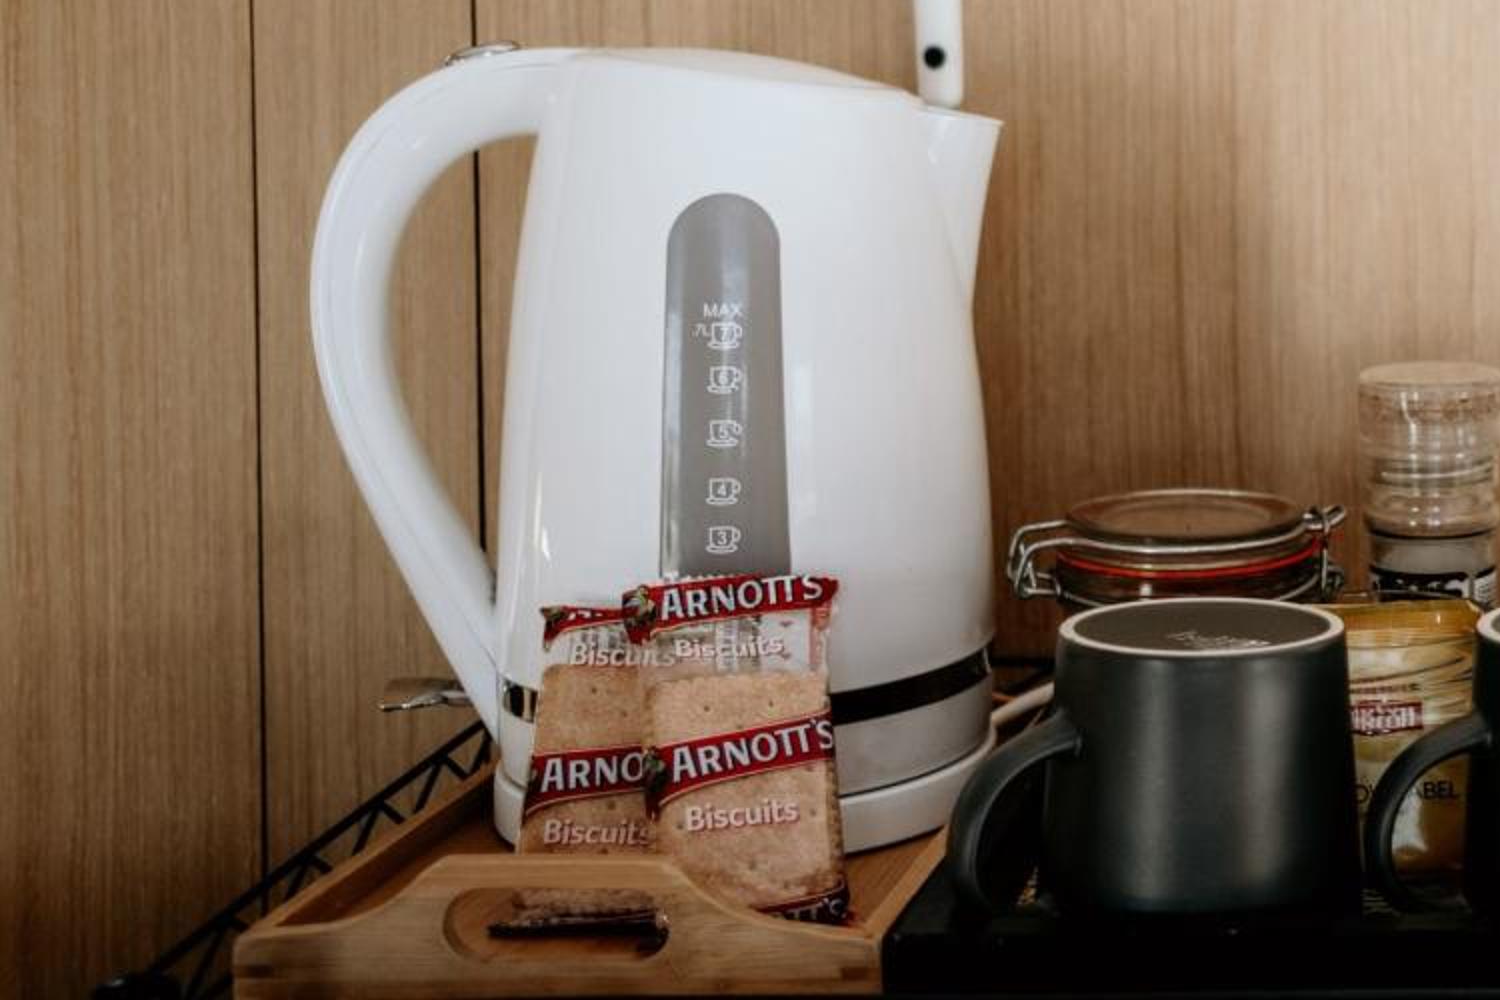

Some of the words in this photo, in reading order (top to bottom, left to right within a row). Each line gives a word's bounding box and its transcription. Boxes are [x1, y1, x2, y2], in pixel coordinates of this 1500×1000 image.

[703, 303, 743, 317] MAX
[660, 574, 824, 621] ARNOTT'S
[674, 635, 785, 659] Biscuits
[671, 718, 833, 784] ARNOTT'S
[685, 799, 800, 832] Biscuits
[543, 818, 649, 847] Biscuits
